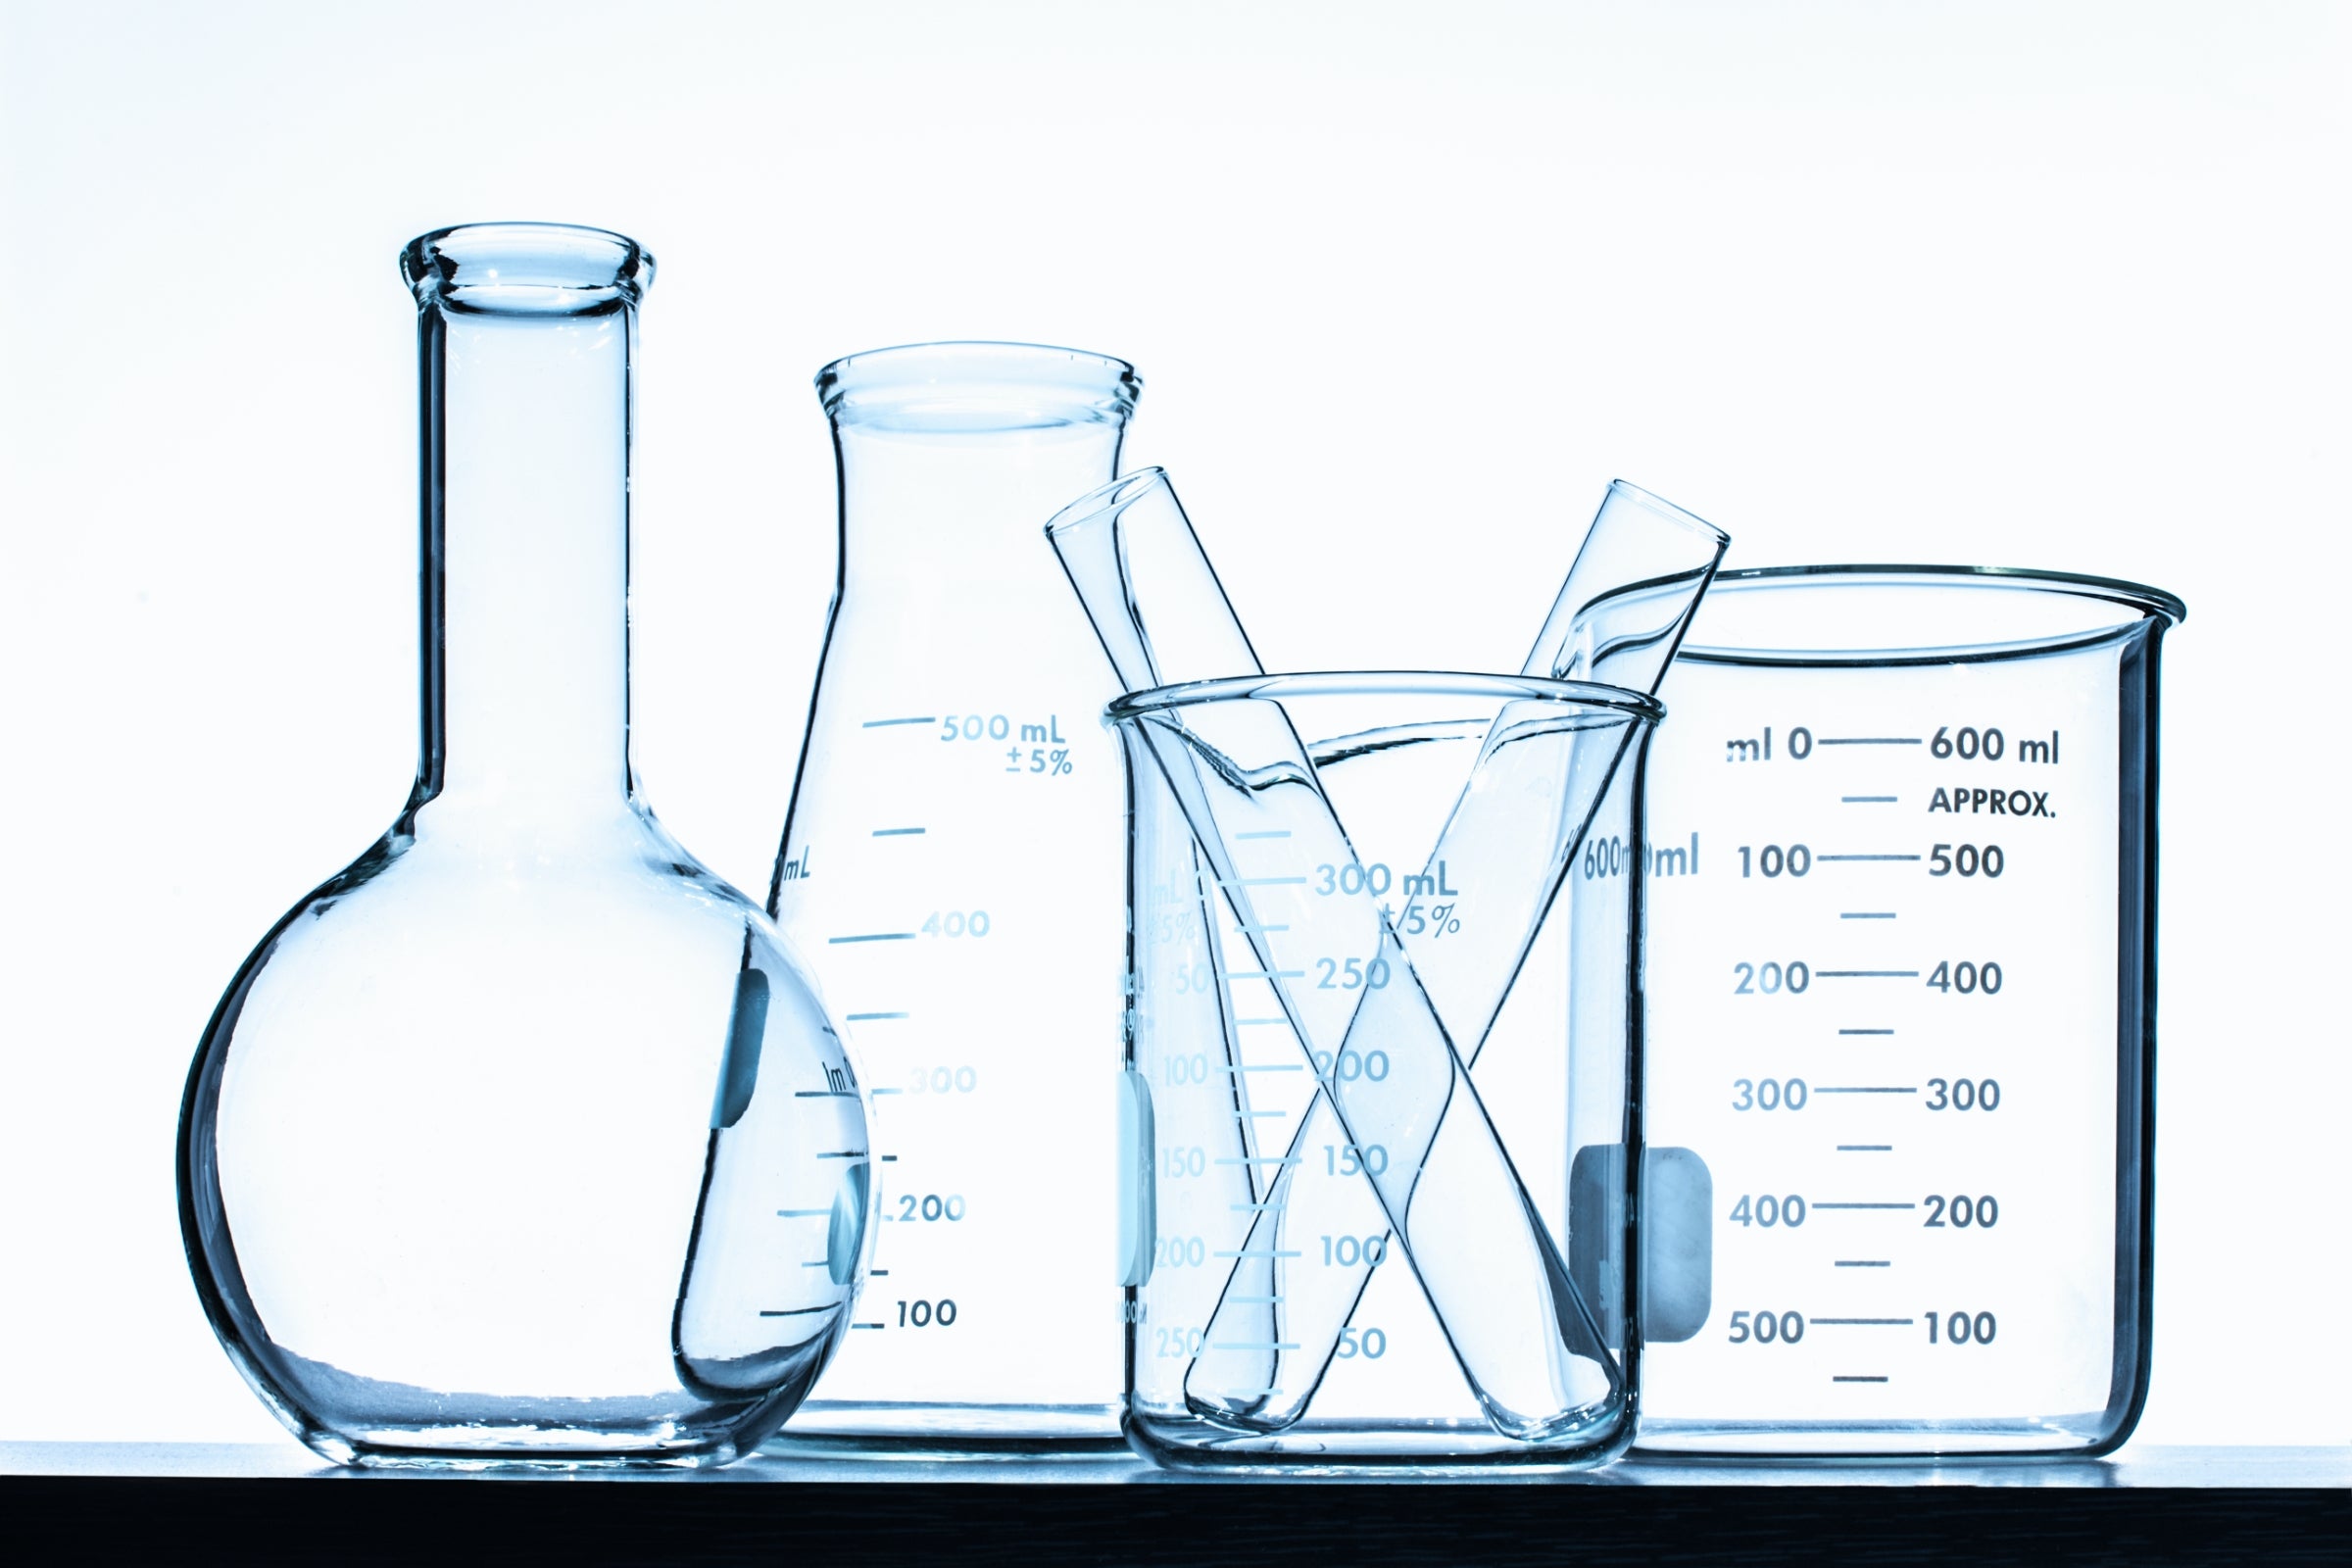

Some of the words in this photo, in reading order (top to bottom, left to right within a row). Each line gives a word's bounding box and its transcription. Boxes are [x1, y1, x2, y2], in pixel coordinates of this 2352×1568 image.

[941, 714, 1010, 742] 500
[1021, 714, 1066, 744] mL
[1727, 726, 1772, 762] ml
[1788, 726, 1813, 760] 0
[1931, 726, 2005, 761] 600
[2019, 729, 2059, 764] ml
[1928, 787, 2056, 819] APPROX.
[1739, 844, 1811, 878] 100
[1929, 844, 2004, 878] 500
[1315, 863, 1392, 896] 300
[1402, 860, 1458, 896] mL
[921, 910, 991, 938] 400
[1176, 963, 1209, 995] 50
[1316, 957, 1391, 989] 250
[1735, 961, 1809, 995] 200
[1927, 961, 2002, 995] 400
[909, 1065, 977, 1095] 300
[1164, 1054, 1208, 1086] 100
[1314, 1051, 1390, 1082] 200
[1733, 1078, 1808, 1111] 300
[1926, 1078, 2001, 1111] 300
[1162, 1147, 1205, 1178] 150
[1324, 1145, 1389, 1176] 150
[900, 1195, 965, 1222] 200
[1730, 1195, 1806, 1228] 400
[1924, 1195, 1998, 1228] 200
[1155, 1237, 1205, 1267] 200
[1321, 1235, 1388, 1267] 100
[898, 1299, 957, 1327] 100
[1729, 1310, 1804, 1344] 500
[1924, 1311, 1996, 1345] 100
[1155, 1327, 1204, 1358] 250
[1337, 1328, 1386, 1359] 50
